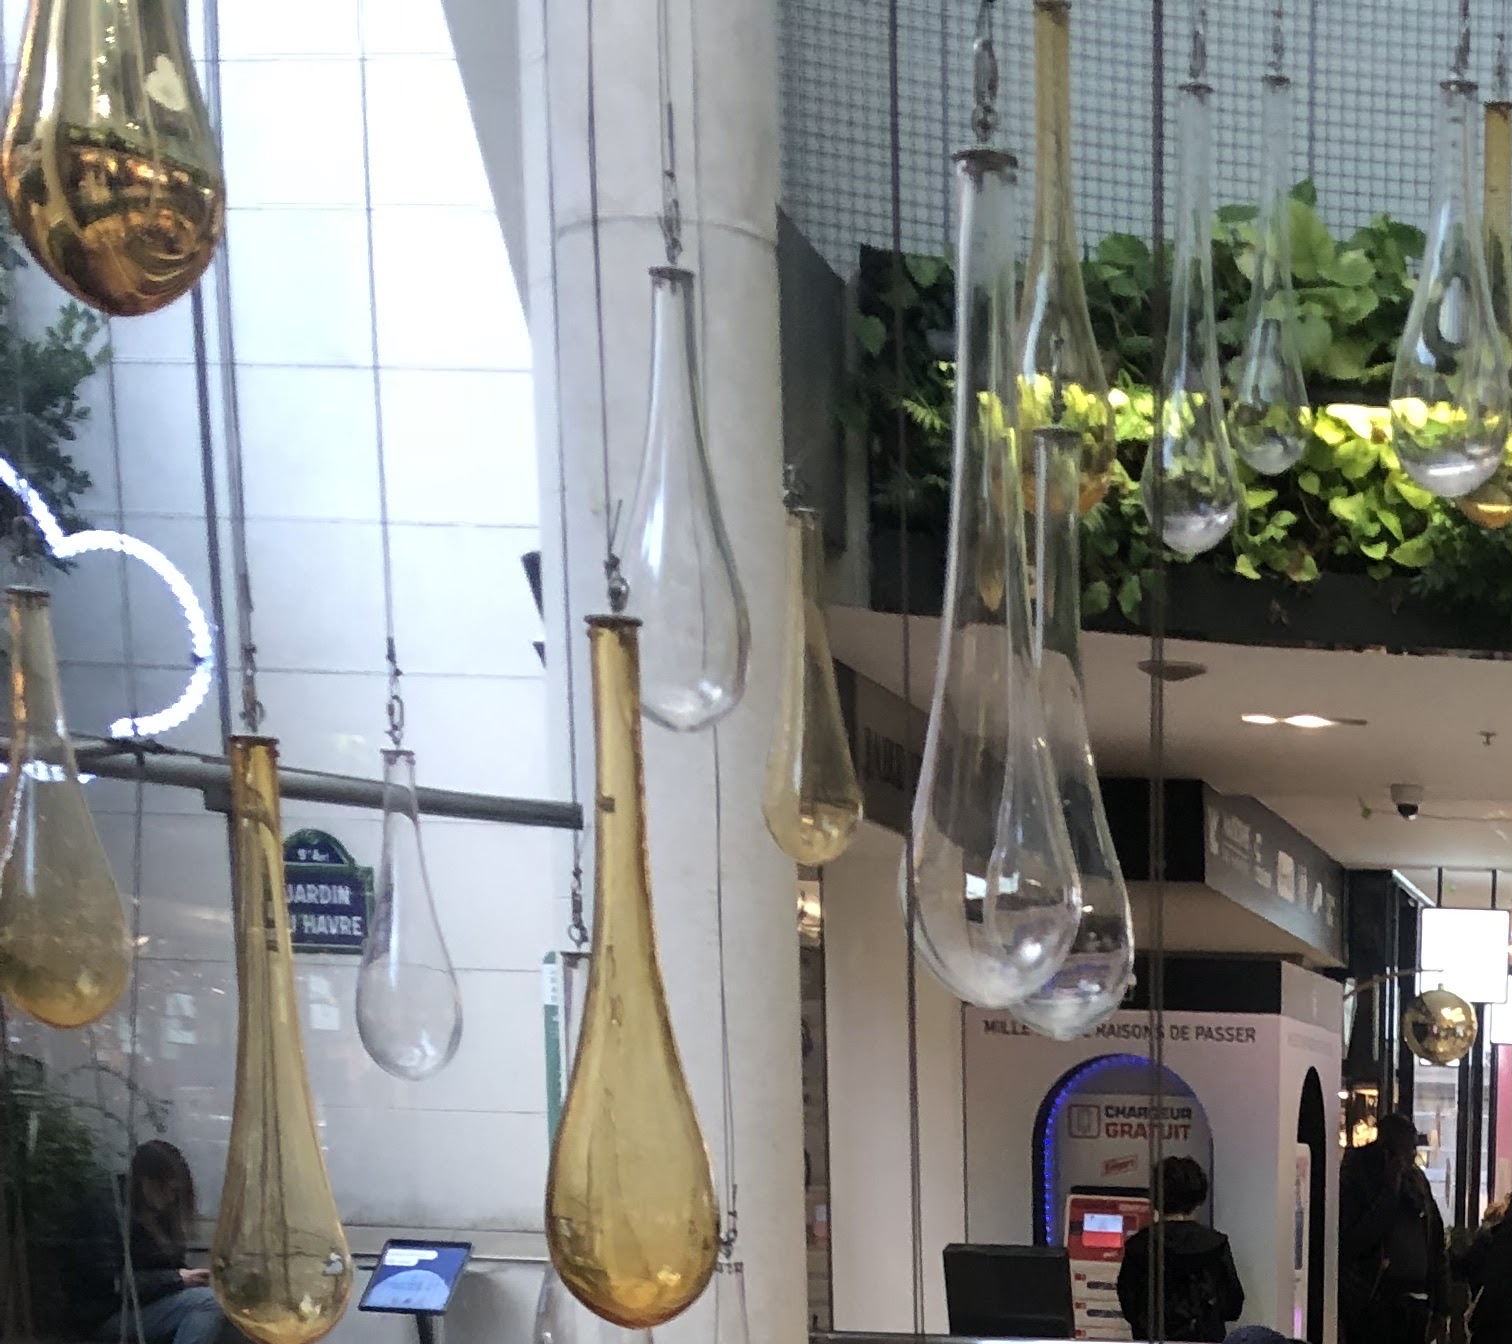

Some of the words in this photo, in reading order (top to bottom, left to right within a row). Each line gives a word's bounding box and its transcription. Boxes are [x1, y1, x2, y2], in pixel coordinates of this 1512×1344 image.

[286, 884, 350, 905] JARDIN
[302, 914, 363, 936] HAVRE
[1170, 1026, 1190, 1041] DE
[1195, 1026, 1256, 1043] PASSER
[1105, 1122, 1192, 1141] GRATUIT
